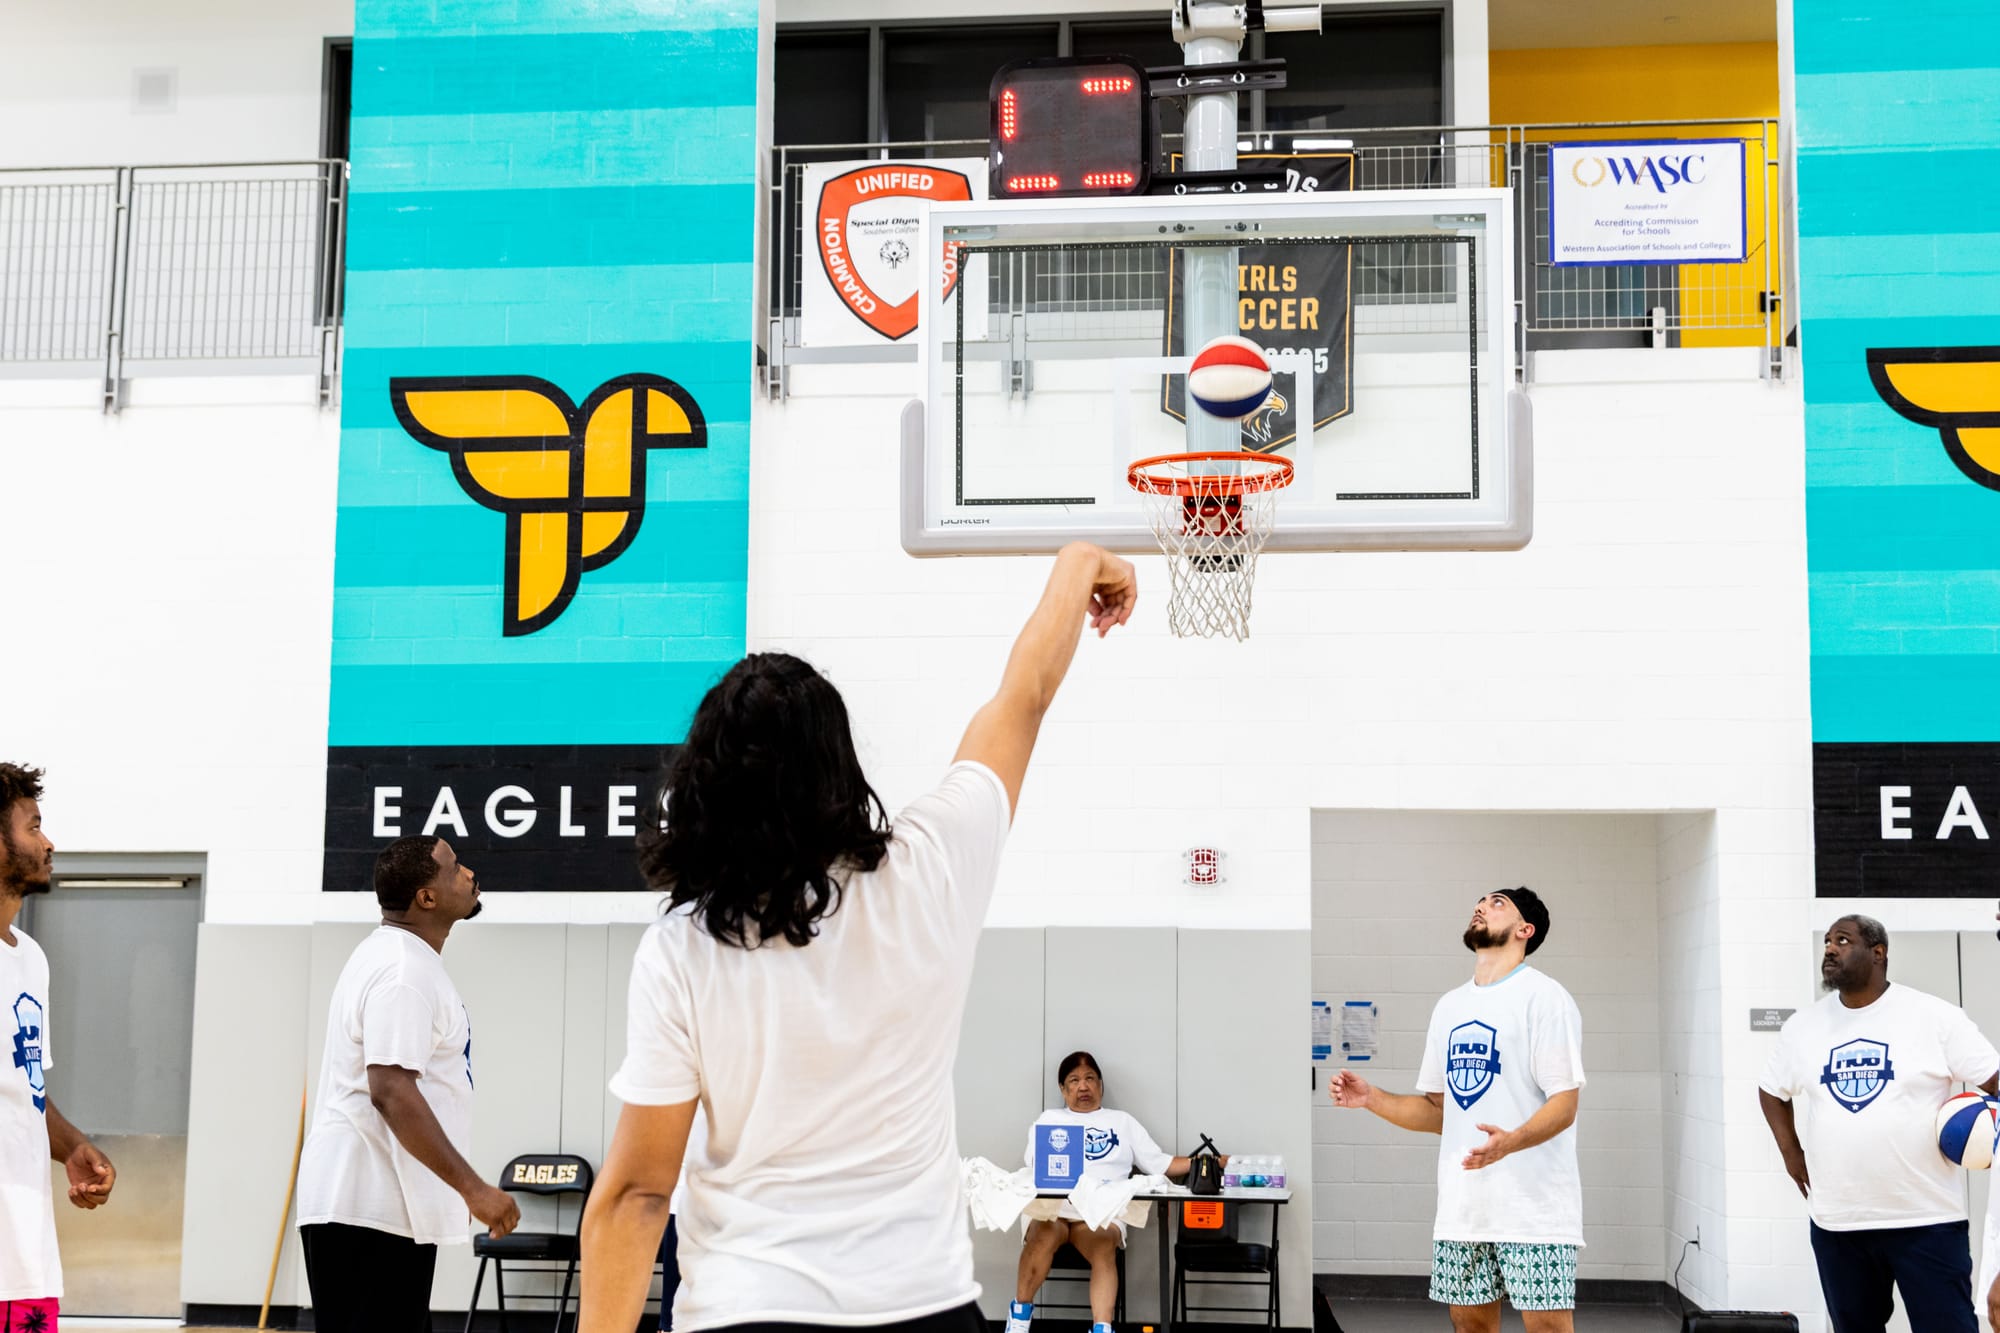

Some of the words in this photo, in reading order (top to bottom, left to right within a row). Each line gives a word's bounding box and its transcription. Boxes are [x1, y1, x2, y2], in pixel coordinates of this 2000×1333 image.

[856, 173, 933, 194] UNIFIED
[1606, 155, 1706, 193] WASC
[851, 219, 888, 228] Special
[1594, 219, 1643, 227] Accrediting
[1646, 217, 1699, 225] Commission
[1622, 228, 1634, 236] for
[1637, 227, 1670, 235] Schools
[1597, 243, 1641, 252] Association
[1700, 241, 1731, 250] Colleges
[824, 218, 876, 315] CHAMPION
[1238, 265, 1297, 292] IRLS
[1239, 297, 1319, 331] CCER
[373, 785, 670, 838] EAGLE
[1880, 786, 1990, 840] EA
[1452, 1059, 1464, 1069] SAN
[1466, 1059, 1486, 1069] DIEGO
[1837, 1072, 1853, 1081] SAN
[1856, 1070, 1878, 1079] DIEGO
[512, 1164, 579, 1184] EAGLES
